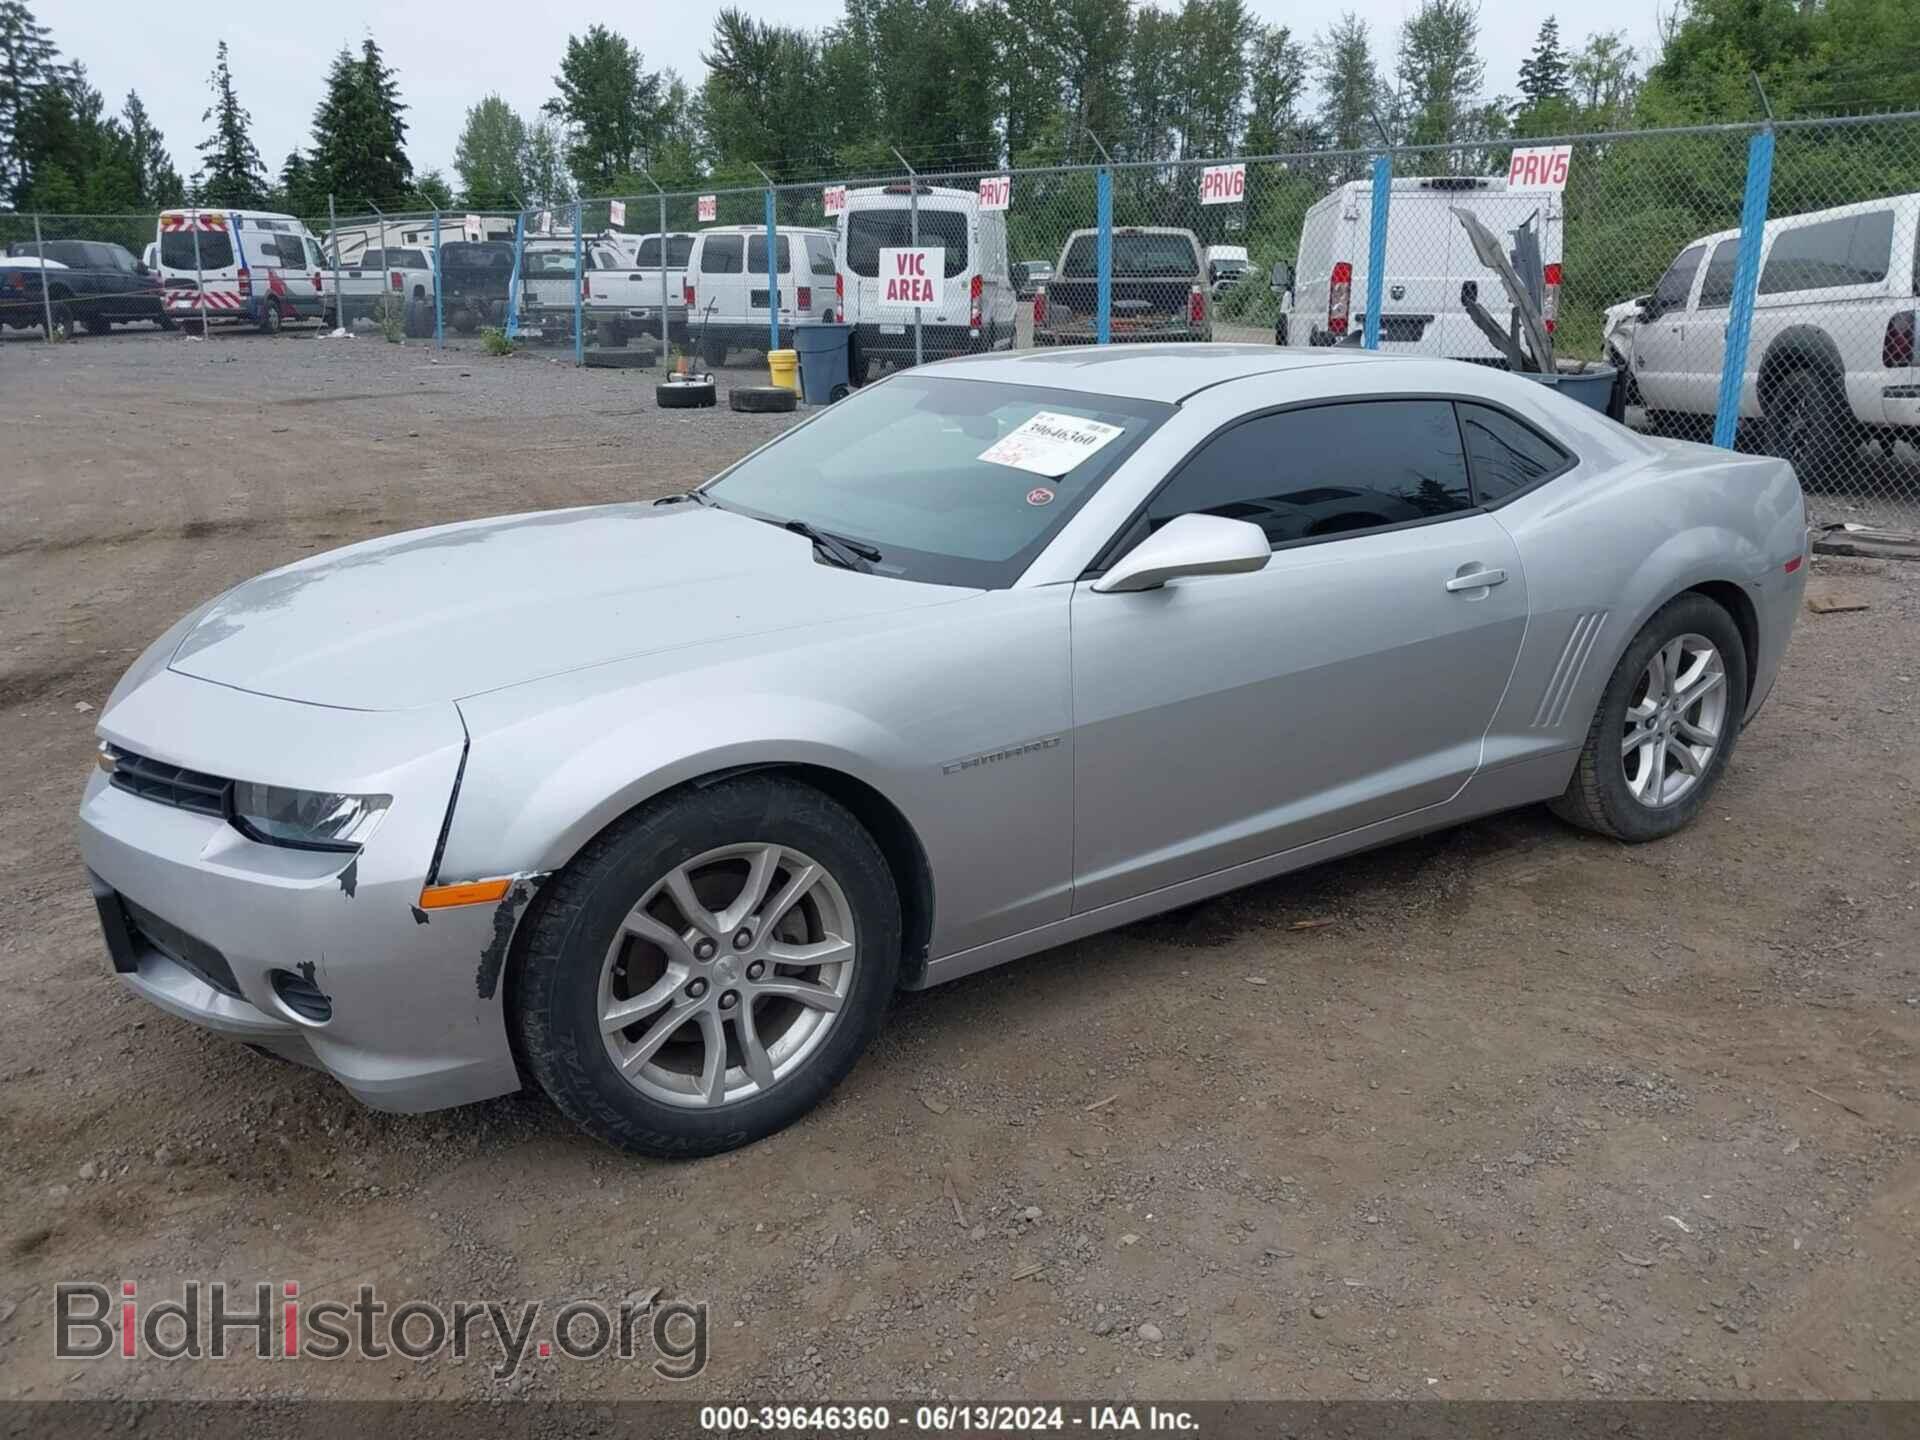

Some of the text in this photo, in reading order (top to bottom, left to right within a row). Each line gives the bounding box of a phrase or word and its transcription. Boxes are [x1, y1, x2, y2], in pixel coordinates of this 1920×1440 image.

[1509, 154, 1568, 186] PRV5
[980, 183, 1008, 205] PRV7
[1204, 171, 1243, 198] PRV6
[896, 253, 925, 276] VIC
[887, 279, 934, 302] AREA
